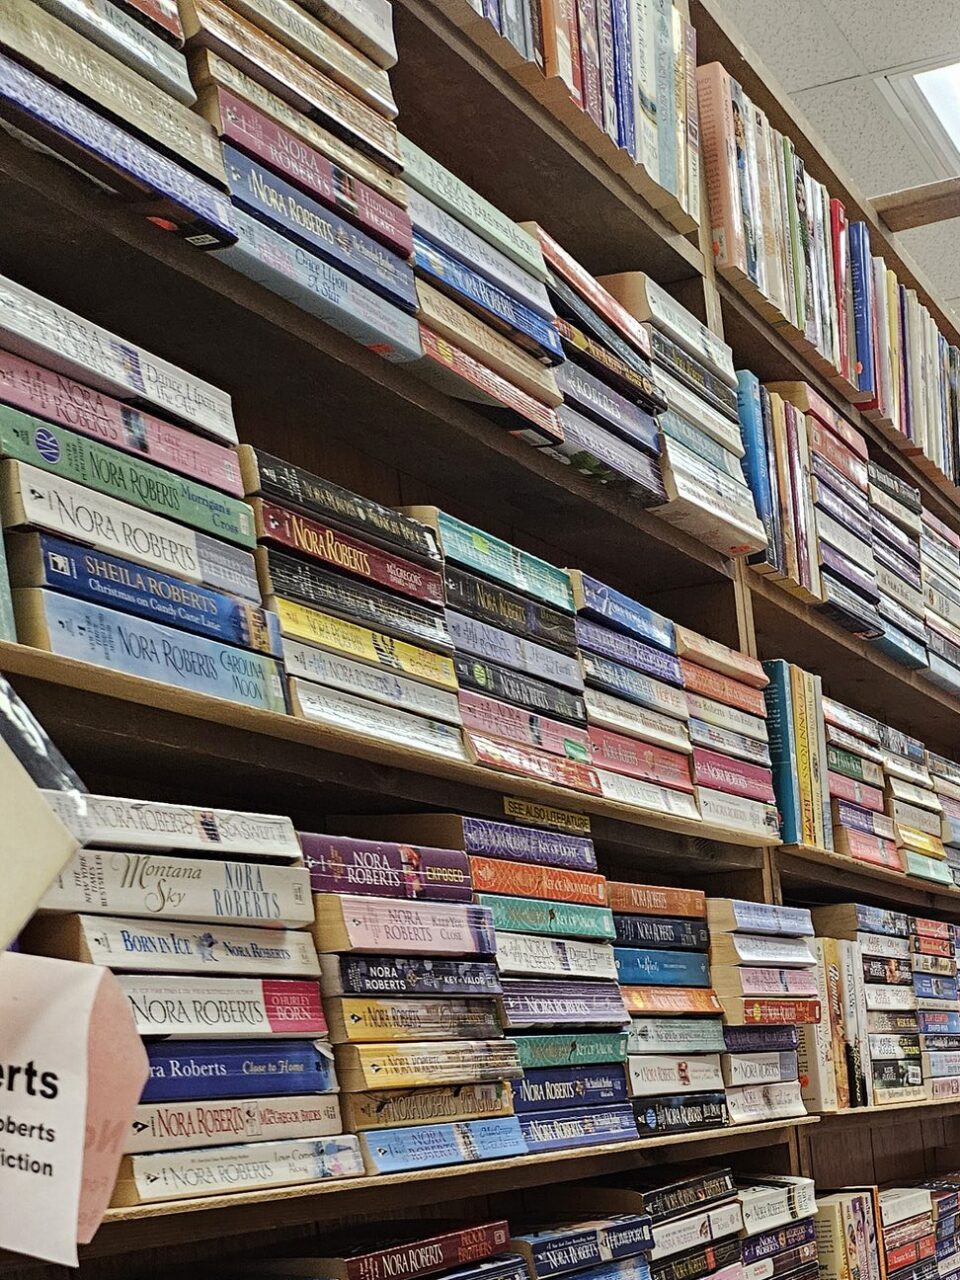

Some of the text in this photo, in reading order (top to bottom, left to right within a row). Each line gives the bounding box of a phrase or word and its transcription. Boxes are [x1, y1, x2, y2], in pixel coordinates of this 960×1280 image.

[250, 170, 334, 245] NORA ROBERTS
[89, 450, 181, 511] NORA ROBERTS
[54, 490, 197, 572] NORA ROBERTS
[212, 511, 239, 535] Cross
[291, 514, 371, 576] NORA ROBERTS
[85, 555, 146, 593] SHEILA
[149, 576, 220, 615] ROBERTS
[117, 624, 219, 681] NORA ROBERTS
[508, 801, 590, 830] SEE ALSO LITERATURE
[111, 853, 202, 889] Montana
[353, 851, 390, 869] NORA
[223, 862, 264, 890] NORA
[347, 867, 400, 886] ROBERTS
[426, 866, 465, 884] EXPOSED
[144, 878, 186, 913] Sky
[213, 888, 282, 918] ROBERTS
[388, 909, 423, 926] NORA
[123, 929, 192, 955] BORN IN ICE
[384, 924, 433, 942] ROBERTS
[223, 942, 291, 961] NORA ROBERTS
[365, 977, 406, 991] ROBERTS
[369, 966, 399, 979] NORA
[444, 975, 485, 987] KEY VALOR
[131, 998, 264, 1026] NORA ROBERTS
[171, 1059, 226, 1079] Roberts
[522, 1081, 575, 1103] NORA ROBERTS
[157, 1105, 246, 1138] NORA ROBERTS
[168, 1161, 275, 1186] NORA ROBERTS
[382, 1243, 444, 1278] NORA ROBERTS
